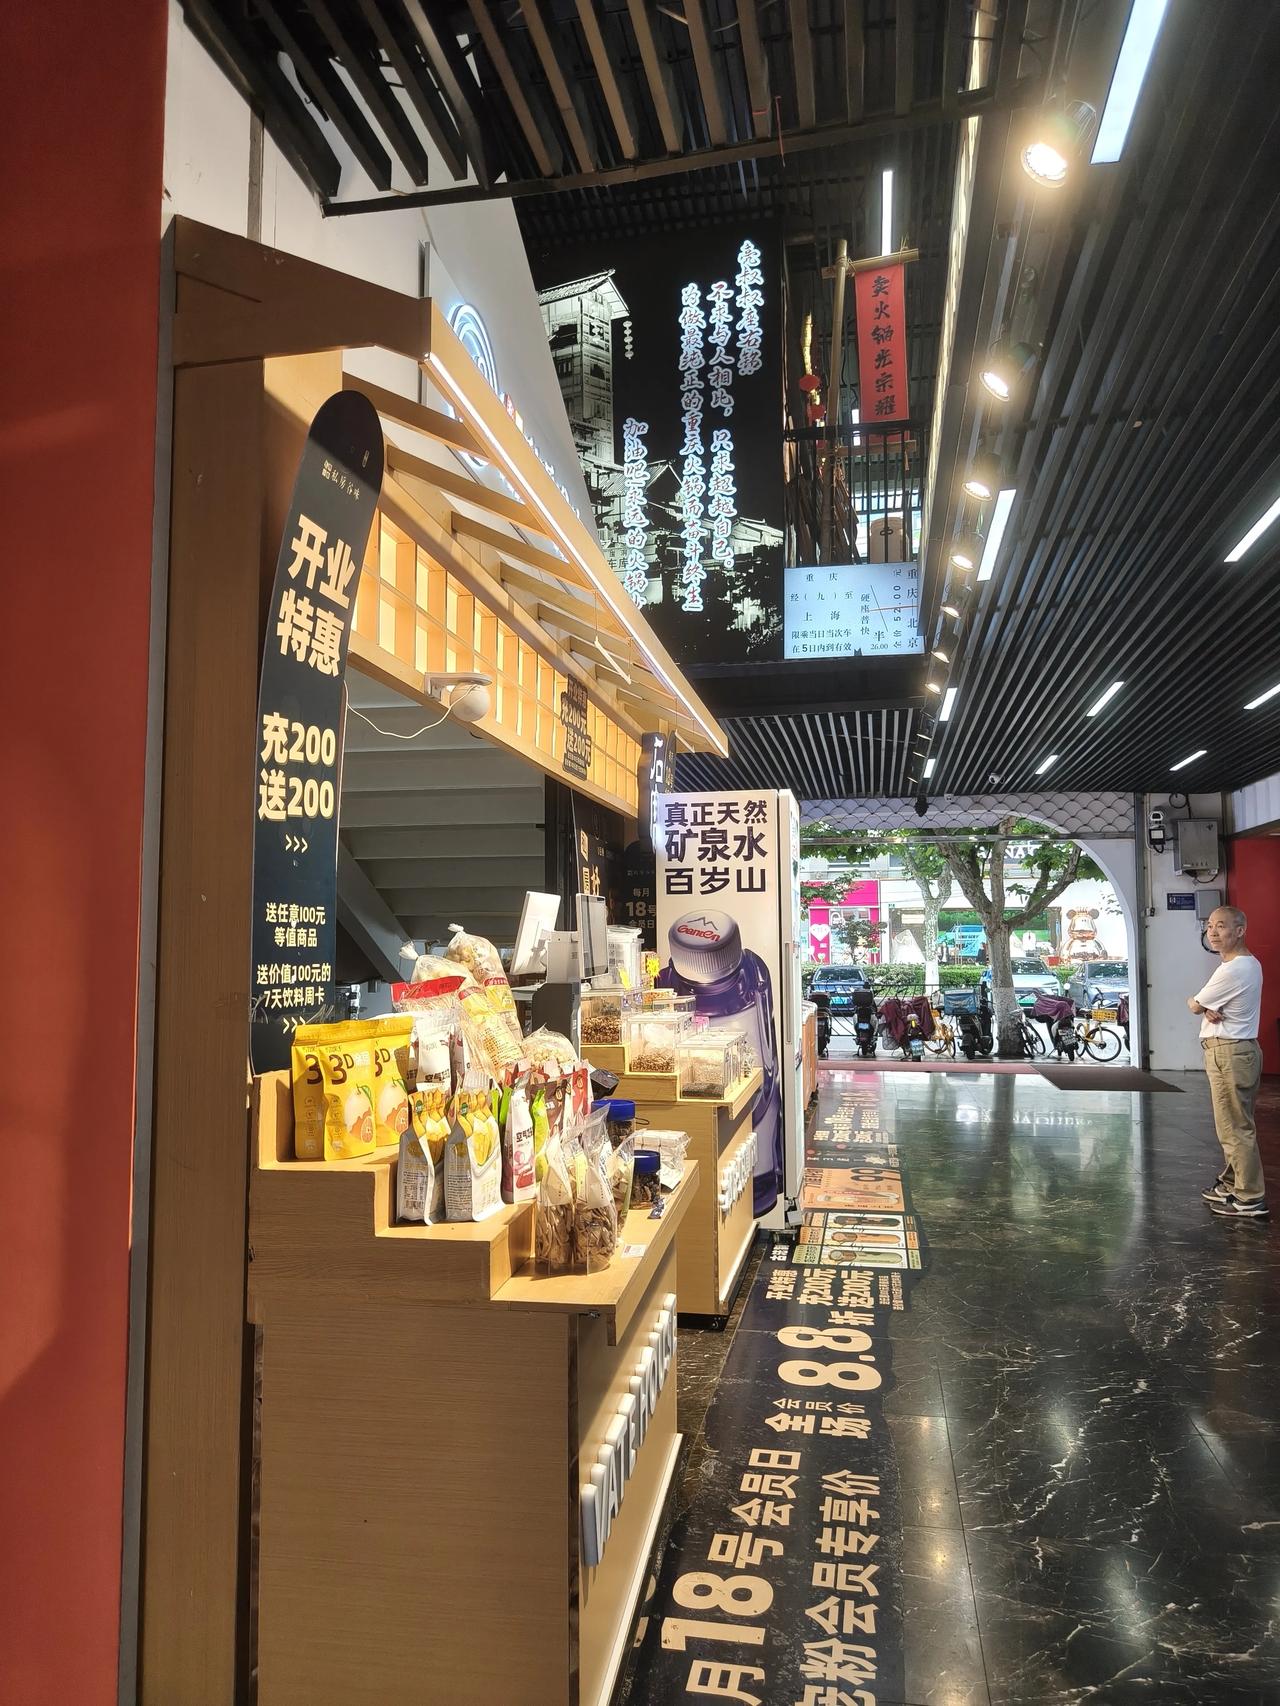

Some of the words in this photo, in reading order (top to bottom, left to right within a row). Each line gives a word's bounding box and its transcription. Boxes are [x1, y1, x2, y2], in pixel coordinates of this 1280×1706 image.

[706, 281, 734, 417] 不求与人相比，
[708, 429, 737, 568] 只求超越自己。
[287, 513, 356, 609] 开业
[803, 610, 840, 621] 上海
[276, 588, 344, 678] 特惠
[562, 694, 587, 736] 充200元
[260, 711, 336, 767] 充200
[567, 726, 591, 765] 送200元
[258, 767, 335, 822] 送200
[664, 800, 768, 827] 真正天然
[664, 826, 768, 863] 矿泉水
[633, 887, 649, 897] 每月
[664, 866, 766, 896] 百岁山
[265, 902, 326, 925] 送任意100元
[625, 901, 657, 917] 18号
[274, 926, 318, 948] 等值商品
[256, 962, 331, 985] 送价值100元的
[264, 986, 325, 1010] 7天饮料周卡
[328, 1053, 355, 1086] 3D
[766, 1269, 798, 1300] 开业特惠
[797, 1268, 837, 1307] 充200元
[837, 1270, 875, 1309] 送200元
[772, 1398, 866, 1415] 会员价
[765, 1412, 872, 1439] 全场
